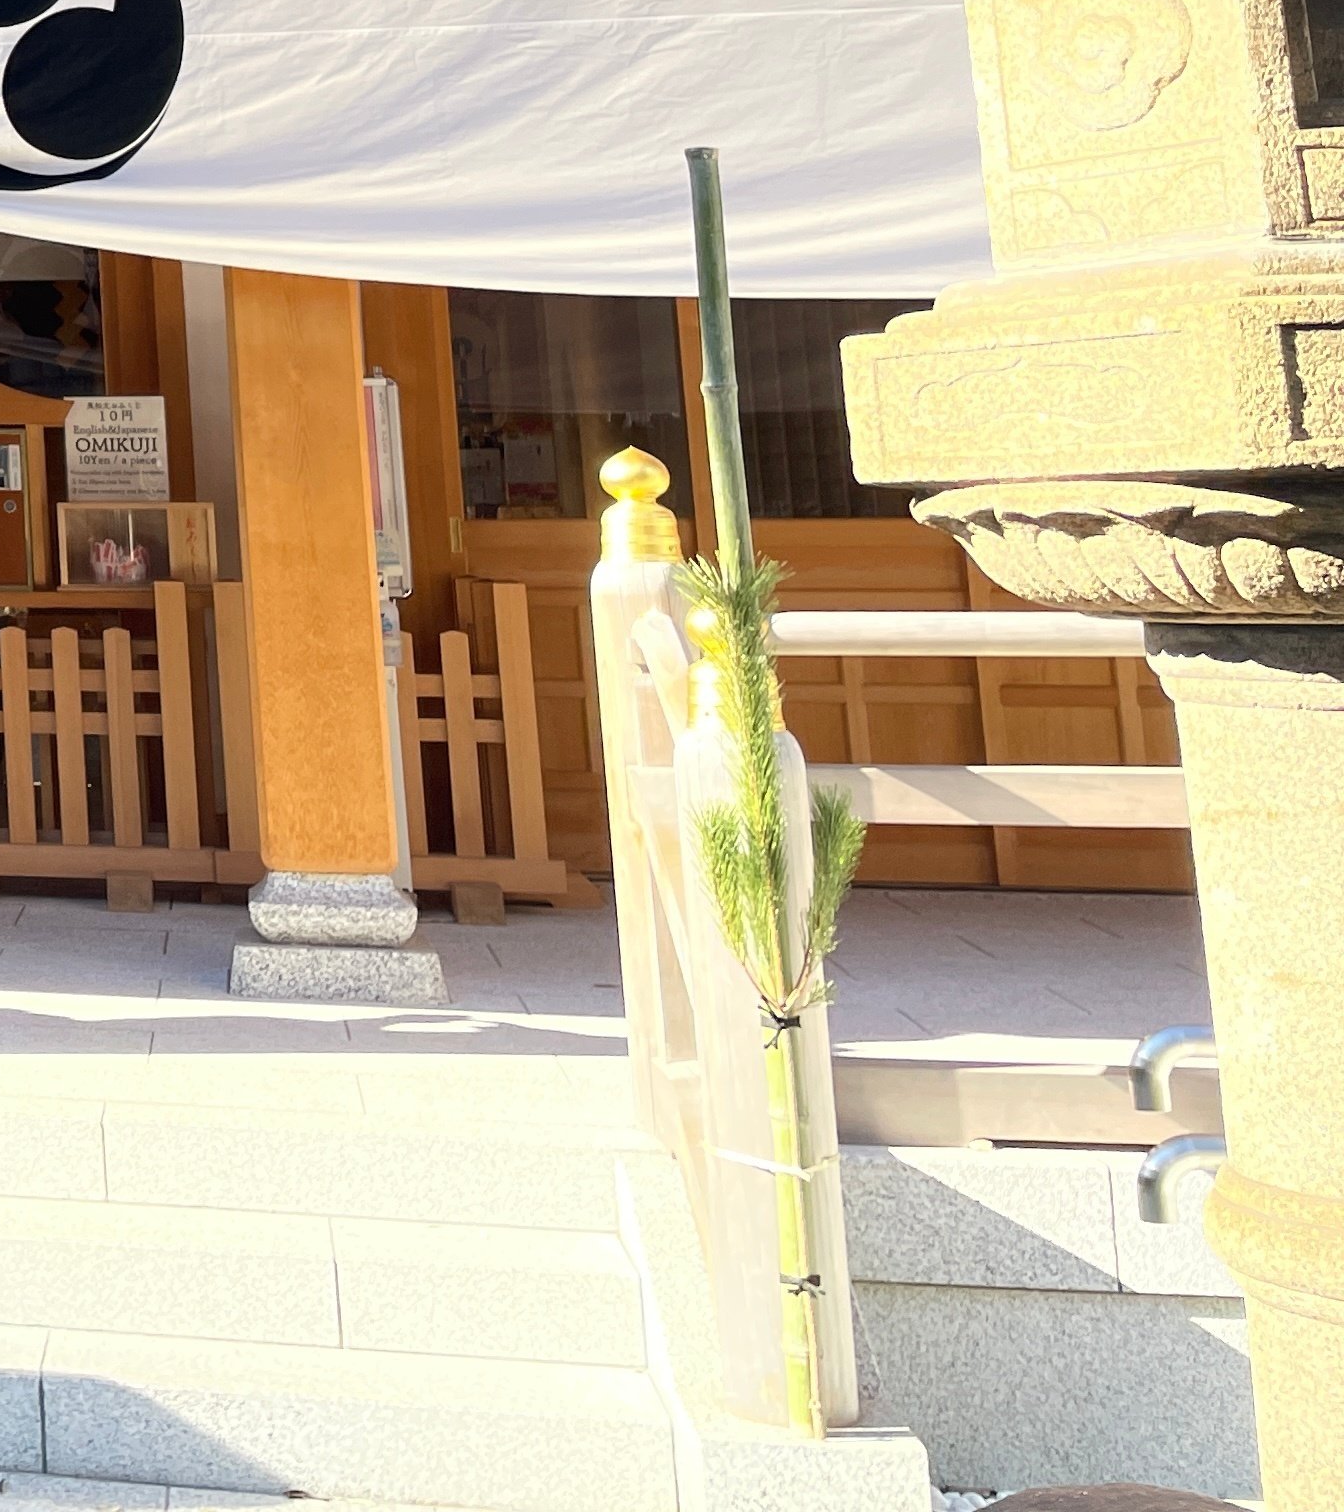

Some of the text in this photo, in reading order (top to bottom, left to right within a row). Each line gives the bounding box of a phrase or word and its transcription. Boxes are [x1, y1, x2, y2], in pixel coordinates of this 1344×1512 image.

[73, 425, 158, 437] English&Japanese
[75, 438, 158, 455] OMIKUJI
[79, 455, 111, 465] 10Yen
[130, 455, 157, 467] piece
